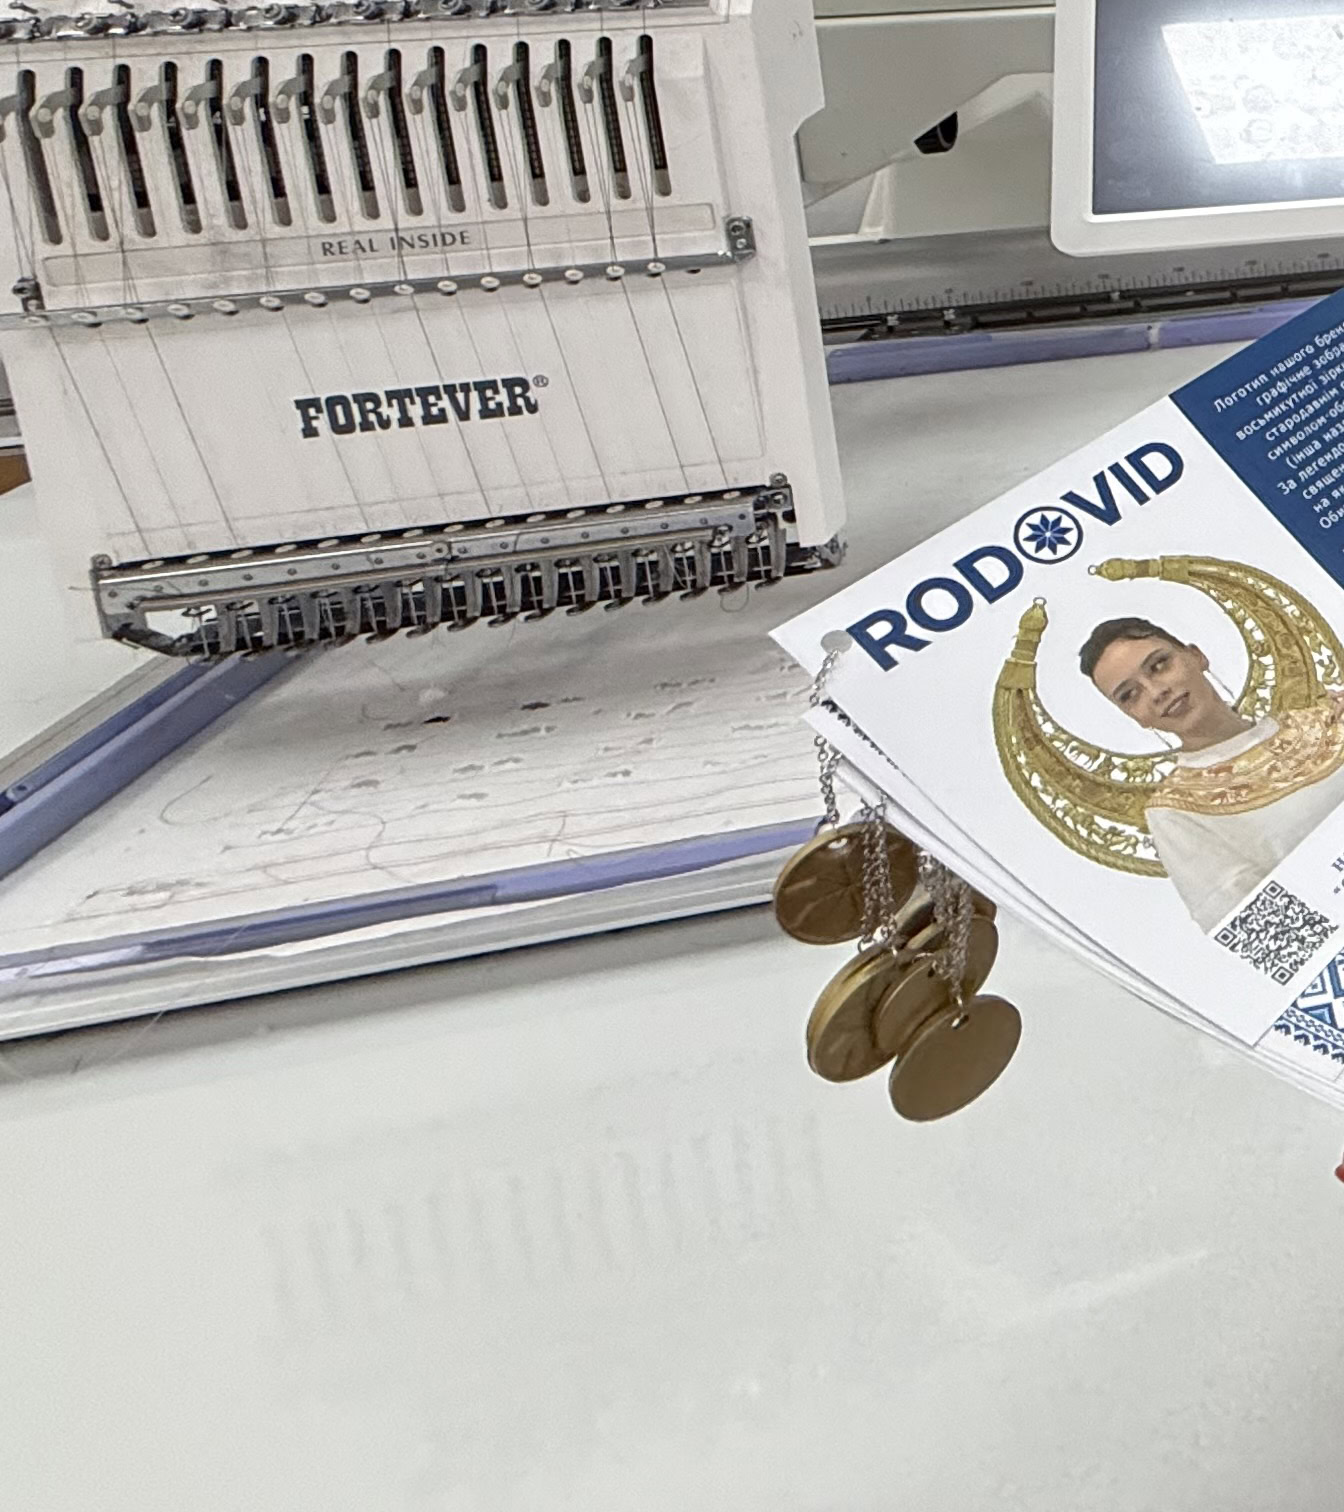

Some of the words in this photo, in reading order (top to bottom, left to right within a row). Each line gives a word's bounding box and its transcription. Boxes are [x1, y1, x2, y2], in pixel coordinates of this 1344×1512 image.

[321, 238, 379, 257] REAL
[390, 229, 472, 251] INSIDE
[1214, 374, 1268, 412] Логотип
[1270, 345, 1314, 376] нашого
[1256, 366, 1312, 405] графічне
[1236, 382, 1318, 440] восьмикутної
[1266, 388, 1338, 441] стародавнім
[1286, 440, 1321, 468] (інша
[1277, 479, 1297, 495] За
[1313, 498, 1330, 512] на
